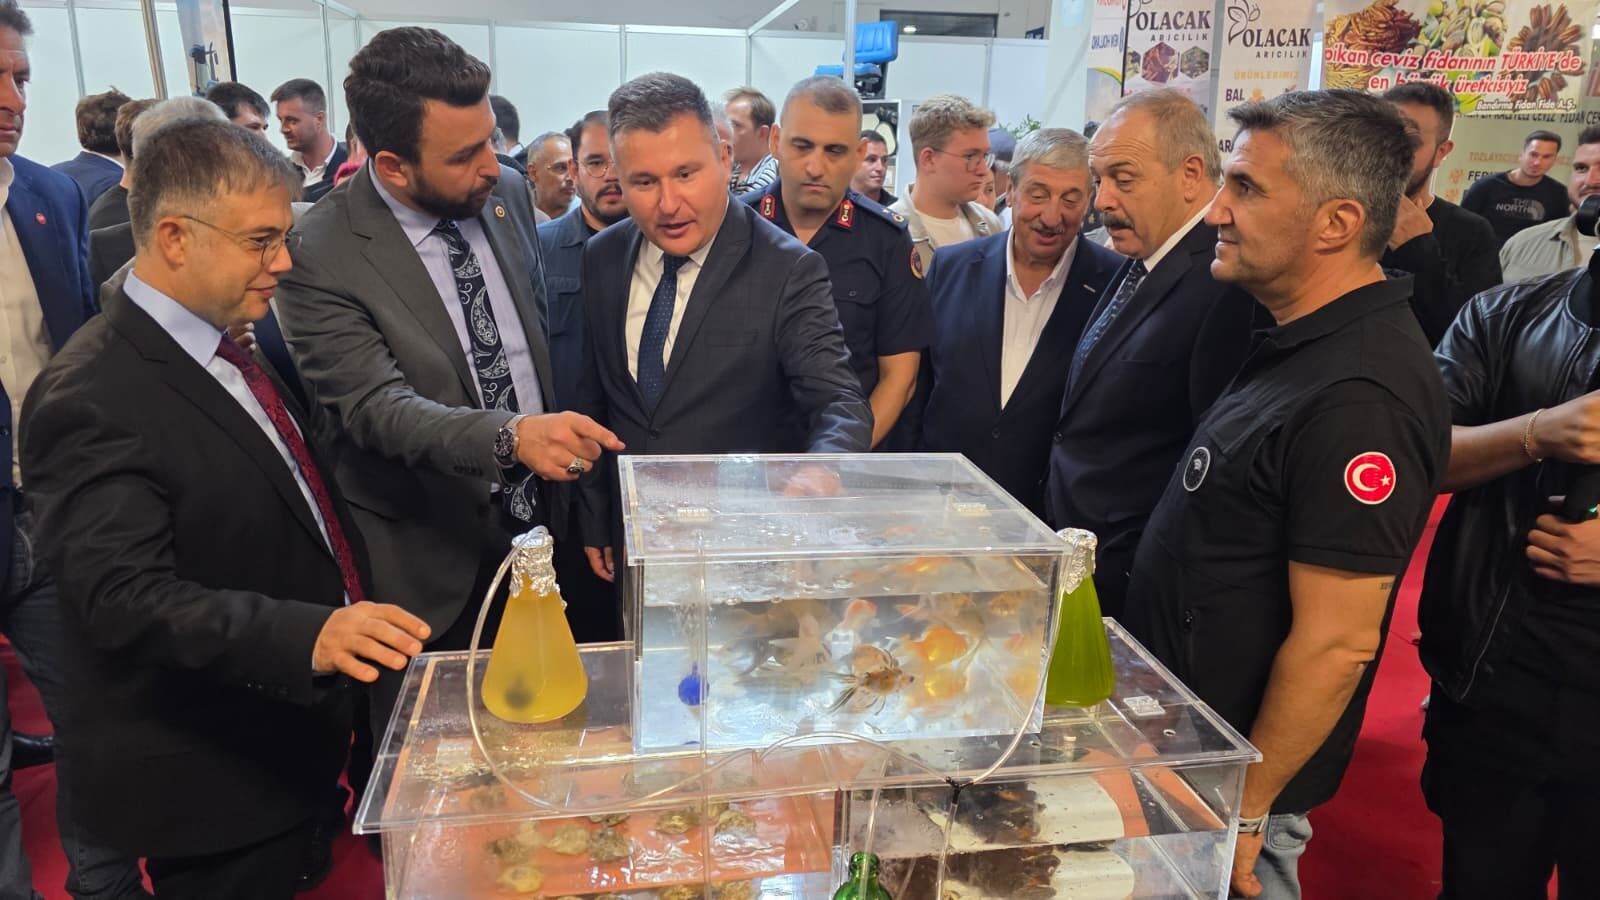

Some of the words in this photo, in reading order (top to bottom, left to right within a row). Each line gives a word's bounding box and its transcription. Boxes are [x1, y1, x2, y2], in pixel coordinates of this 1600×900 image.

[1136, 11, 1211, 30] OLACAK
[1243, 28, 1311, 47] OLACAK
[1372, 50, 1419, 68] ceviz
[1370, 77, 1389, 89] en
[1225, 88, 1245, 101] BAL
